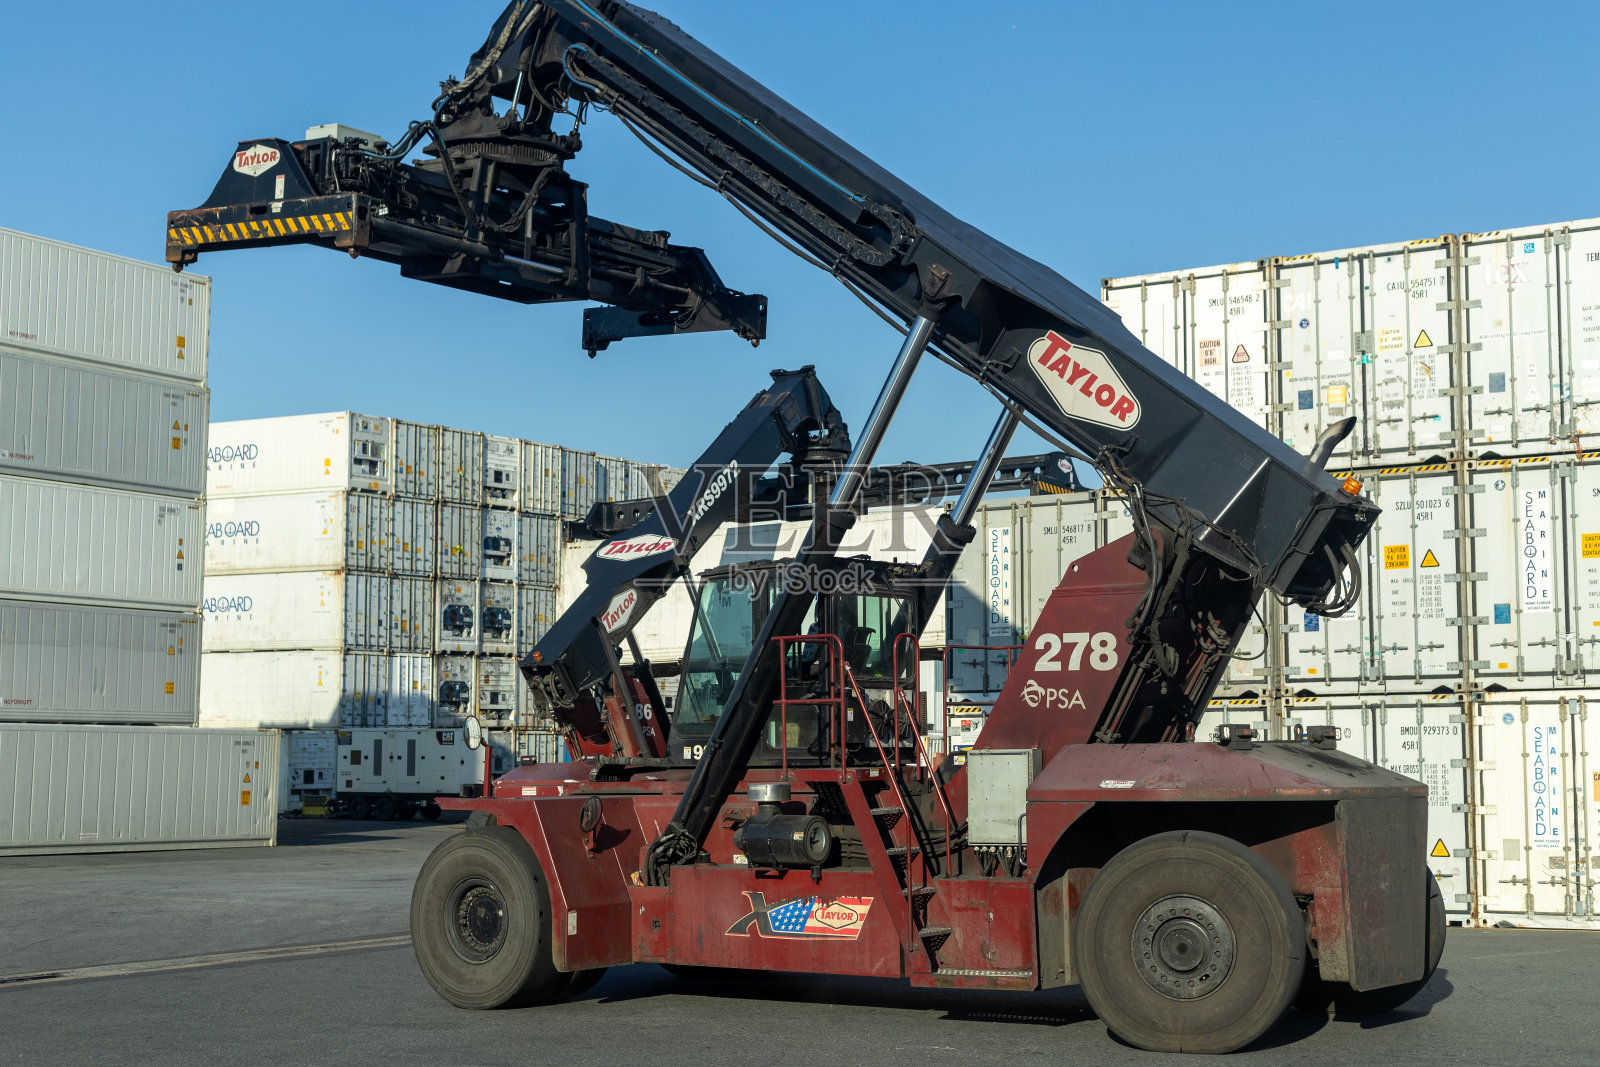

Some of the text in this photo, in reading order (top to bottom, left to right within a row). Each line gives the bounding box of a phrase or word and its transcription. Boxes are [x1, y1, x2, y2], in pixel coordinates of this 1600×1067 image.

[236, 149, 278, 169] TAYLOR
[1386, 282, 1405, 292] CAIU
[1410, 278, 1436, 289] 554751
[1411, 289, 1428, 299] 45R1
[1208, 298, 1224, 307] SMLU
[1228, 306, 1245, 316] 45R1
[1200, 340, 1221, 349] CAUTION
[1204, 357, 1217, 365] HIGH
[1037, 331, 1135, 423] TAYLOR
[1395, 498, 1450, 511] SZLU 501023 6
[1416, 511, 1433, 521] 45R1
[204, 520, 260, 538] ABOARD
[1043, 526, 1058, 536] SMLU
[1062, 524, 1084, 534] 546817
[1062, 535, 1077, 545] 45R1
[1524, 491, 1537, 599] SEABOARD
[1538, 490, 1548, 598] MARINE
[604, 540, 673, 556] TAYLOR
[1385, 561, 1409, 569] CONTAINER
[990, 529, 1001, 624] SEABOARD
[1002, 528, 1010, 624] MARINE
[602, 591, 635, 630] TAYLOR
[1034, 631, 1119, 672] 278
[1046, 688, 1087, 710] PSA
[442, 732, 454, 742] CAT
[1400, 726, 1418, 736] BMOU
[1423, 726, 1450, 736] 929373
[1401, 740, 1419, 751] 45R1
[1390, 764, 1420, 774] MAX GROSS
[1532, 726, 1547, 836] SEABOARD
[1548, 726, 1559, 836] MARINE
[819, 907, 854, 921] TAYLOR
